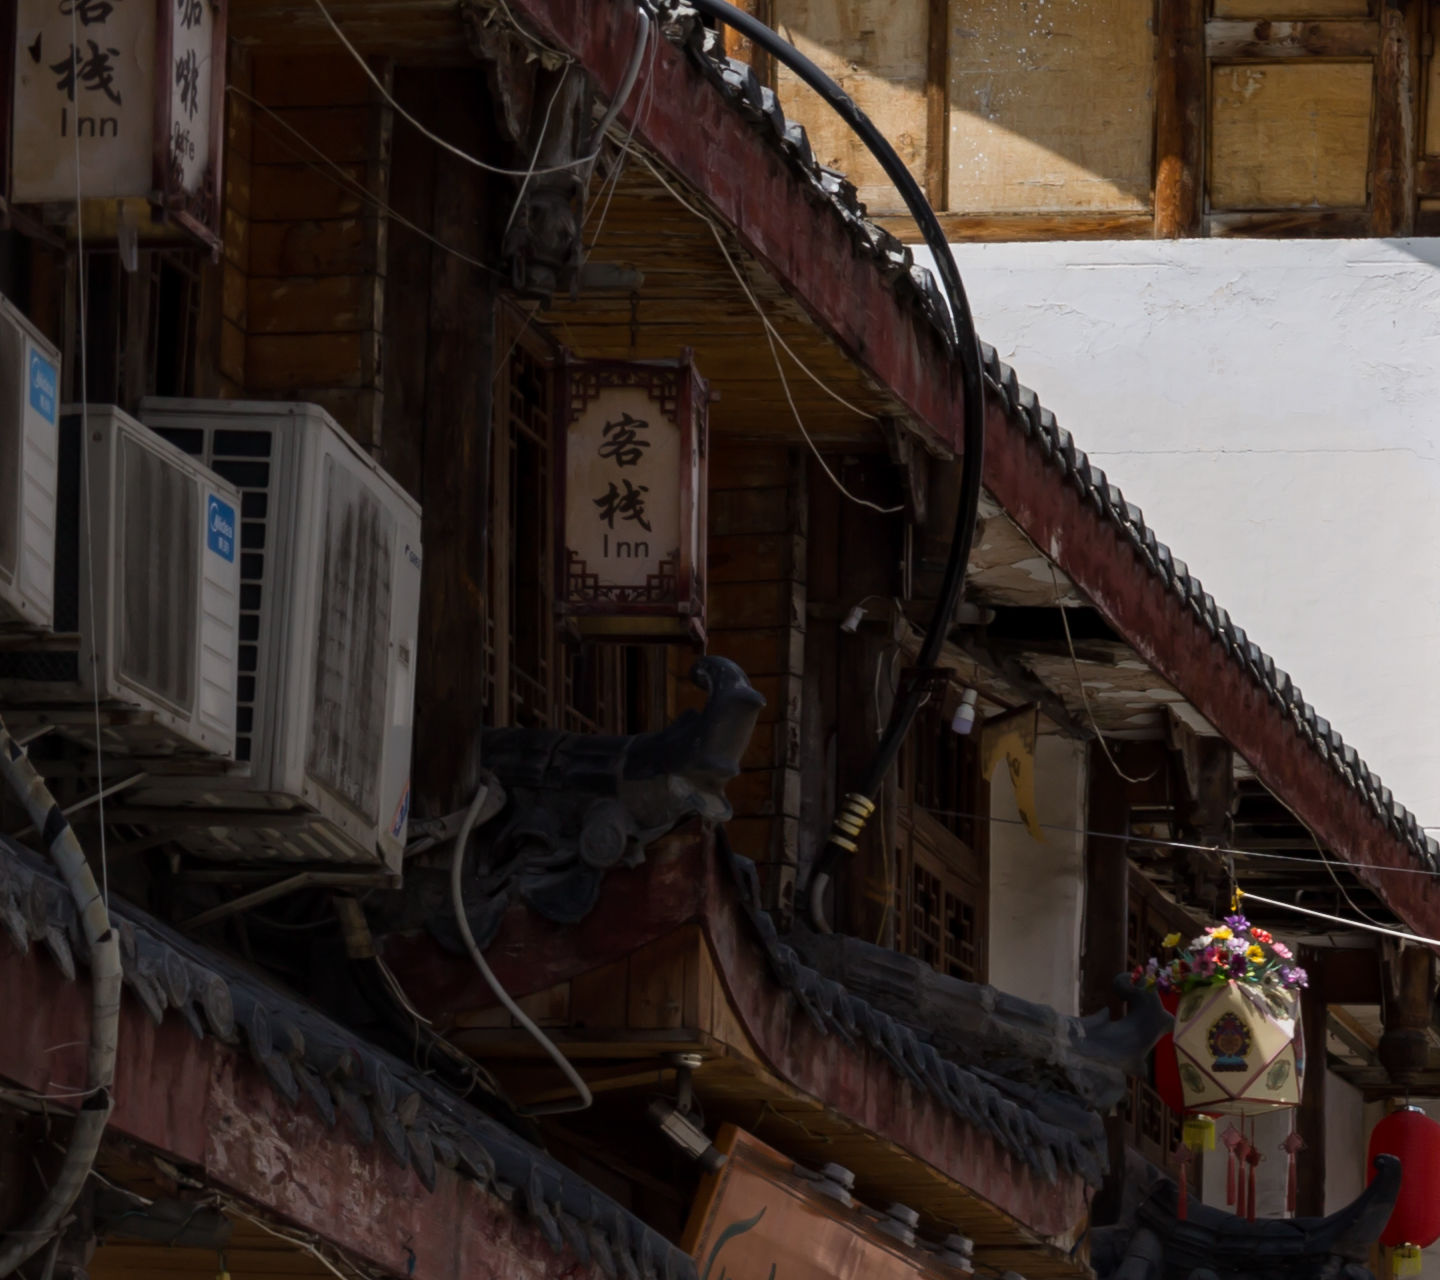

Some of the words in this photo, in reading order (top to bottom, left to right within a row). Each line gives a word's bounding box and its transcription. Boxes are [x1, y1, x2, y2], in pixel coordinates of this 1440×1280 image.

[61, 107, 118, 137] Inn
[592, 412, 652, 532] 客栈
[603, 534, 649, 557] Inn
